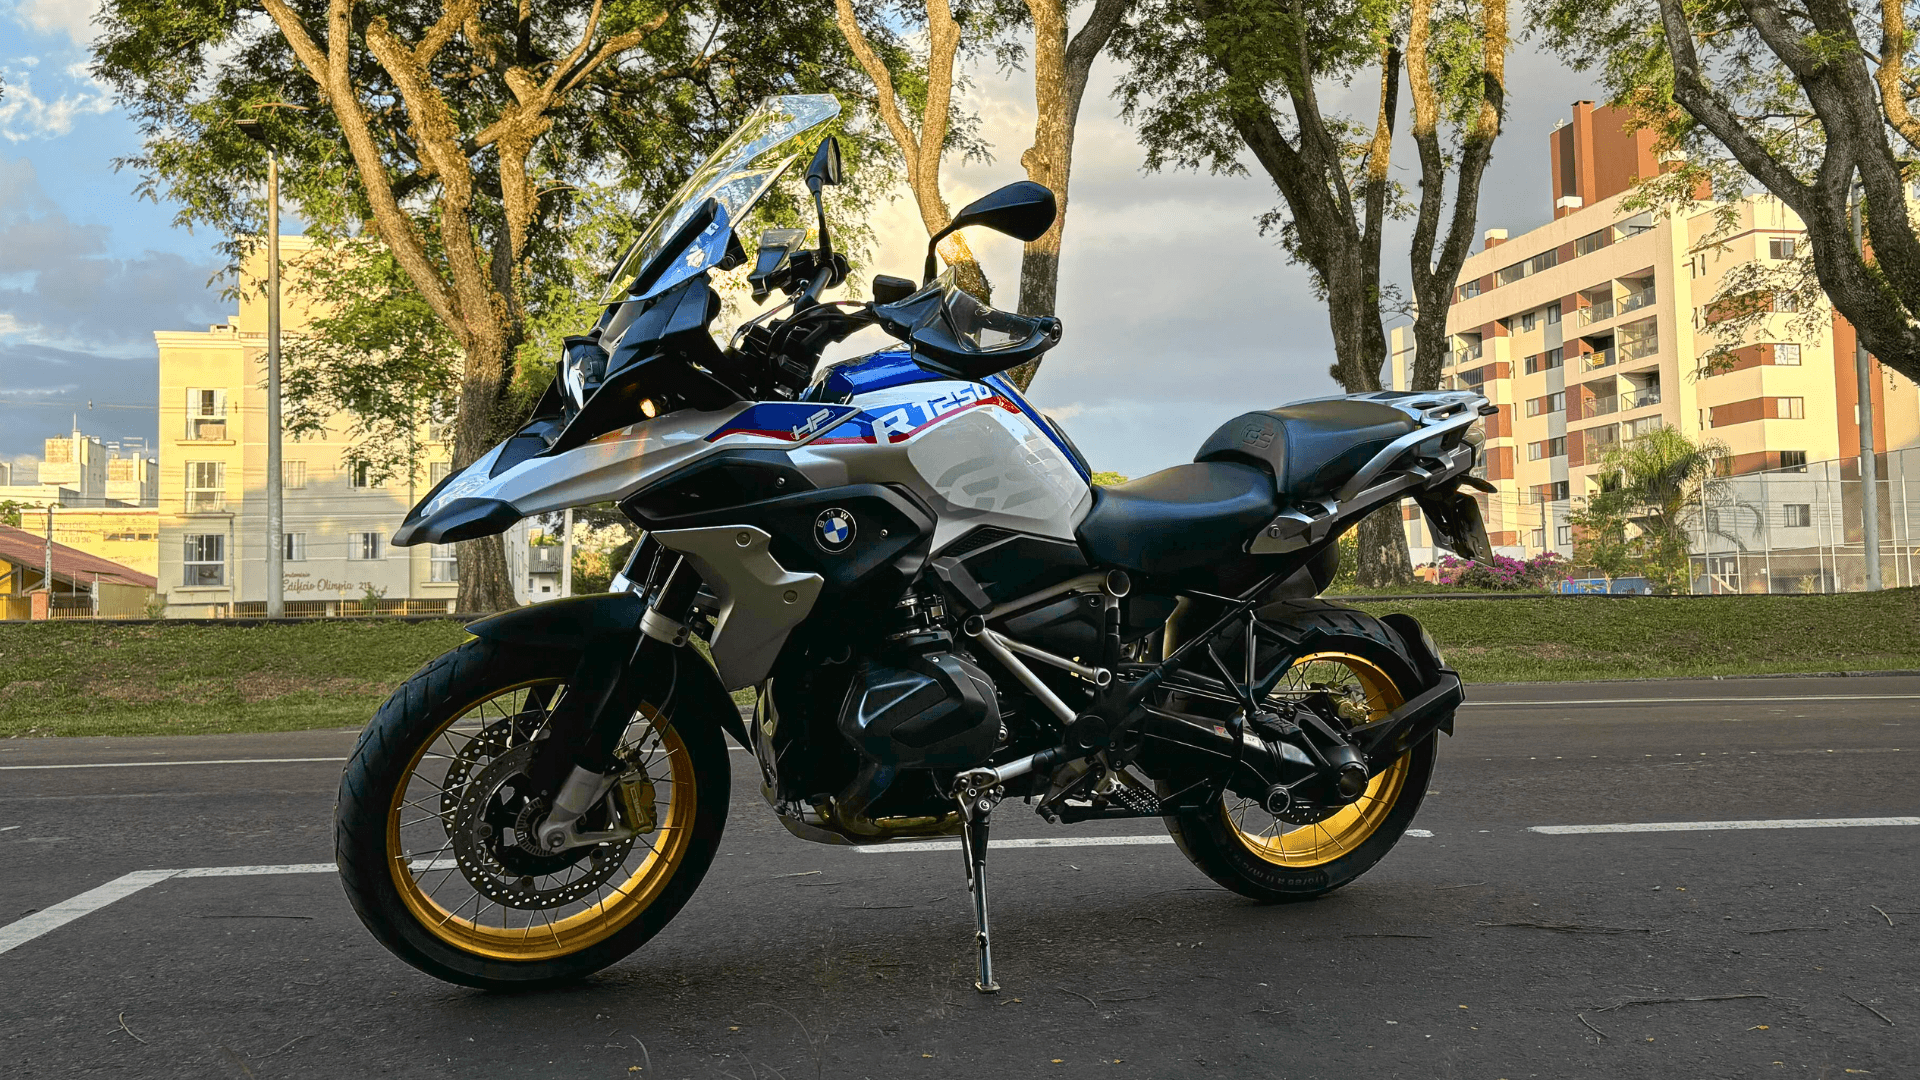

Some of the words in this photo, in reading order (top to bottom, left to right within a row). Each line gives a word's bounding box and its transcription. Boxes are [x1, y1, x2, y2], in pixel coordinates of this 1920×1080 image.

[792, 408, 832, 440] HP
[871, 407, 917, 446] R
[912, 385, 992, 421] 1250
[817, 510, 849, 528] BMW
